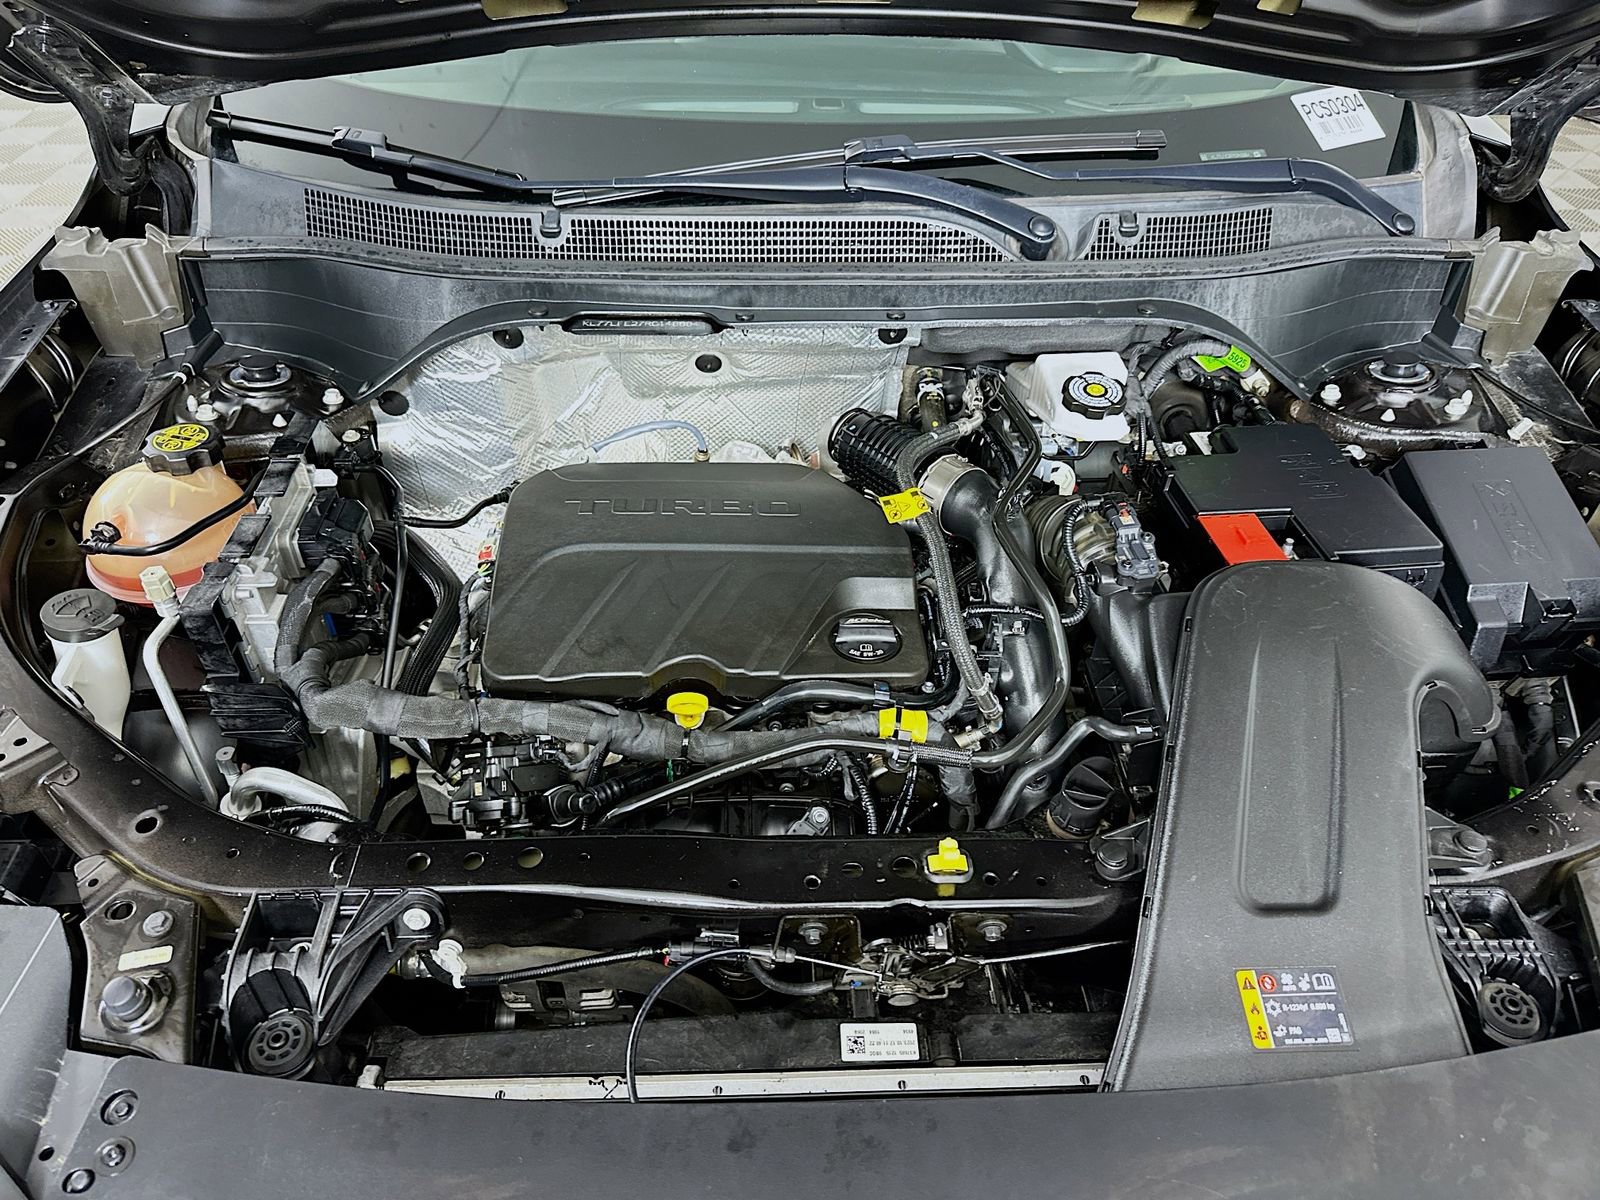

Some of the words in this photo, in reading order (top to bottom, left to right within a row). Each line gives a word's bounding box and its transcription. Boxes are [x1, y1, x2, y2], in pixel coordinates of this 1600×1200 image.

[1301, 93, 1366, 121] PCS0304
[1227, 351, 1248, 369] 5925
[565, 499, 800, 517] TURBO
